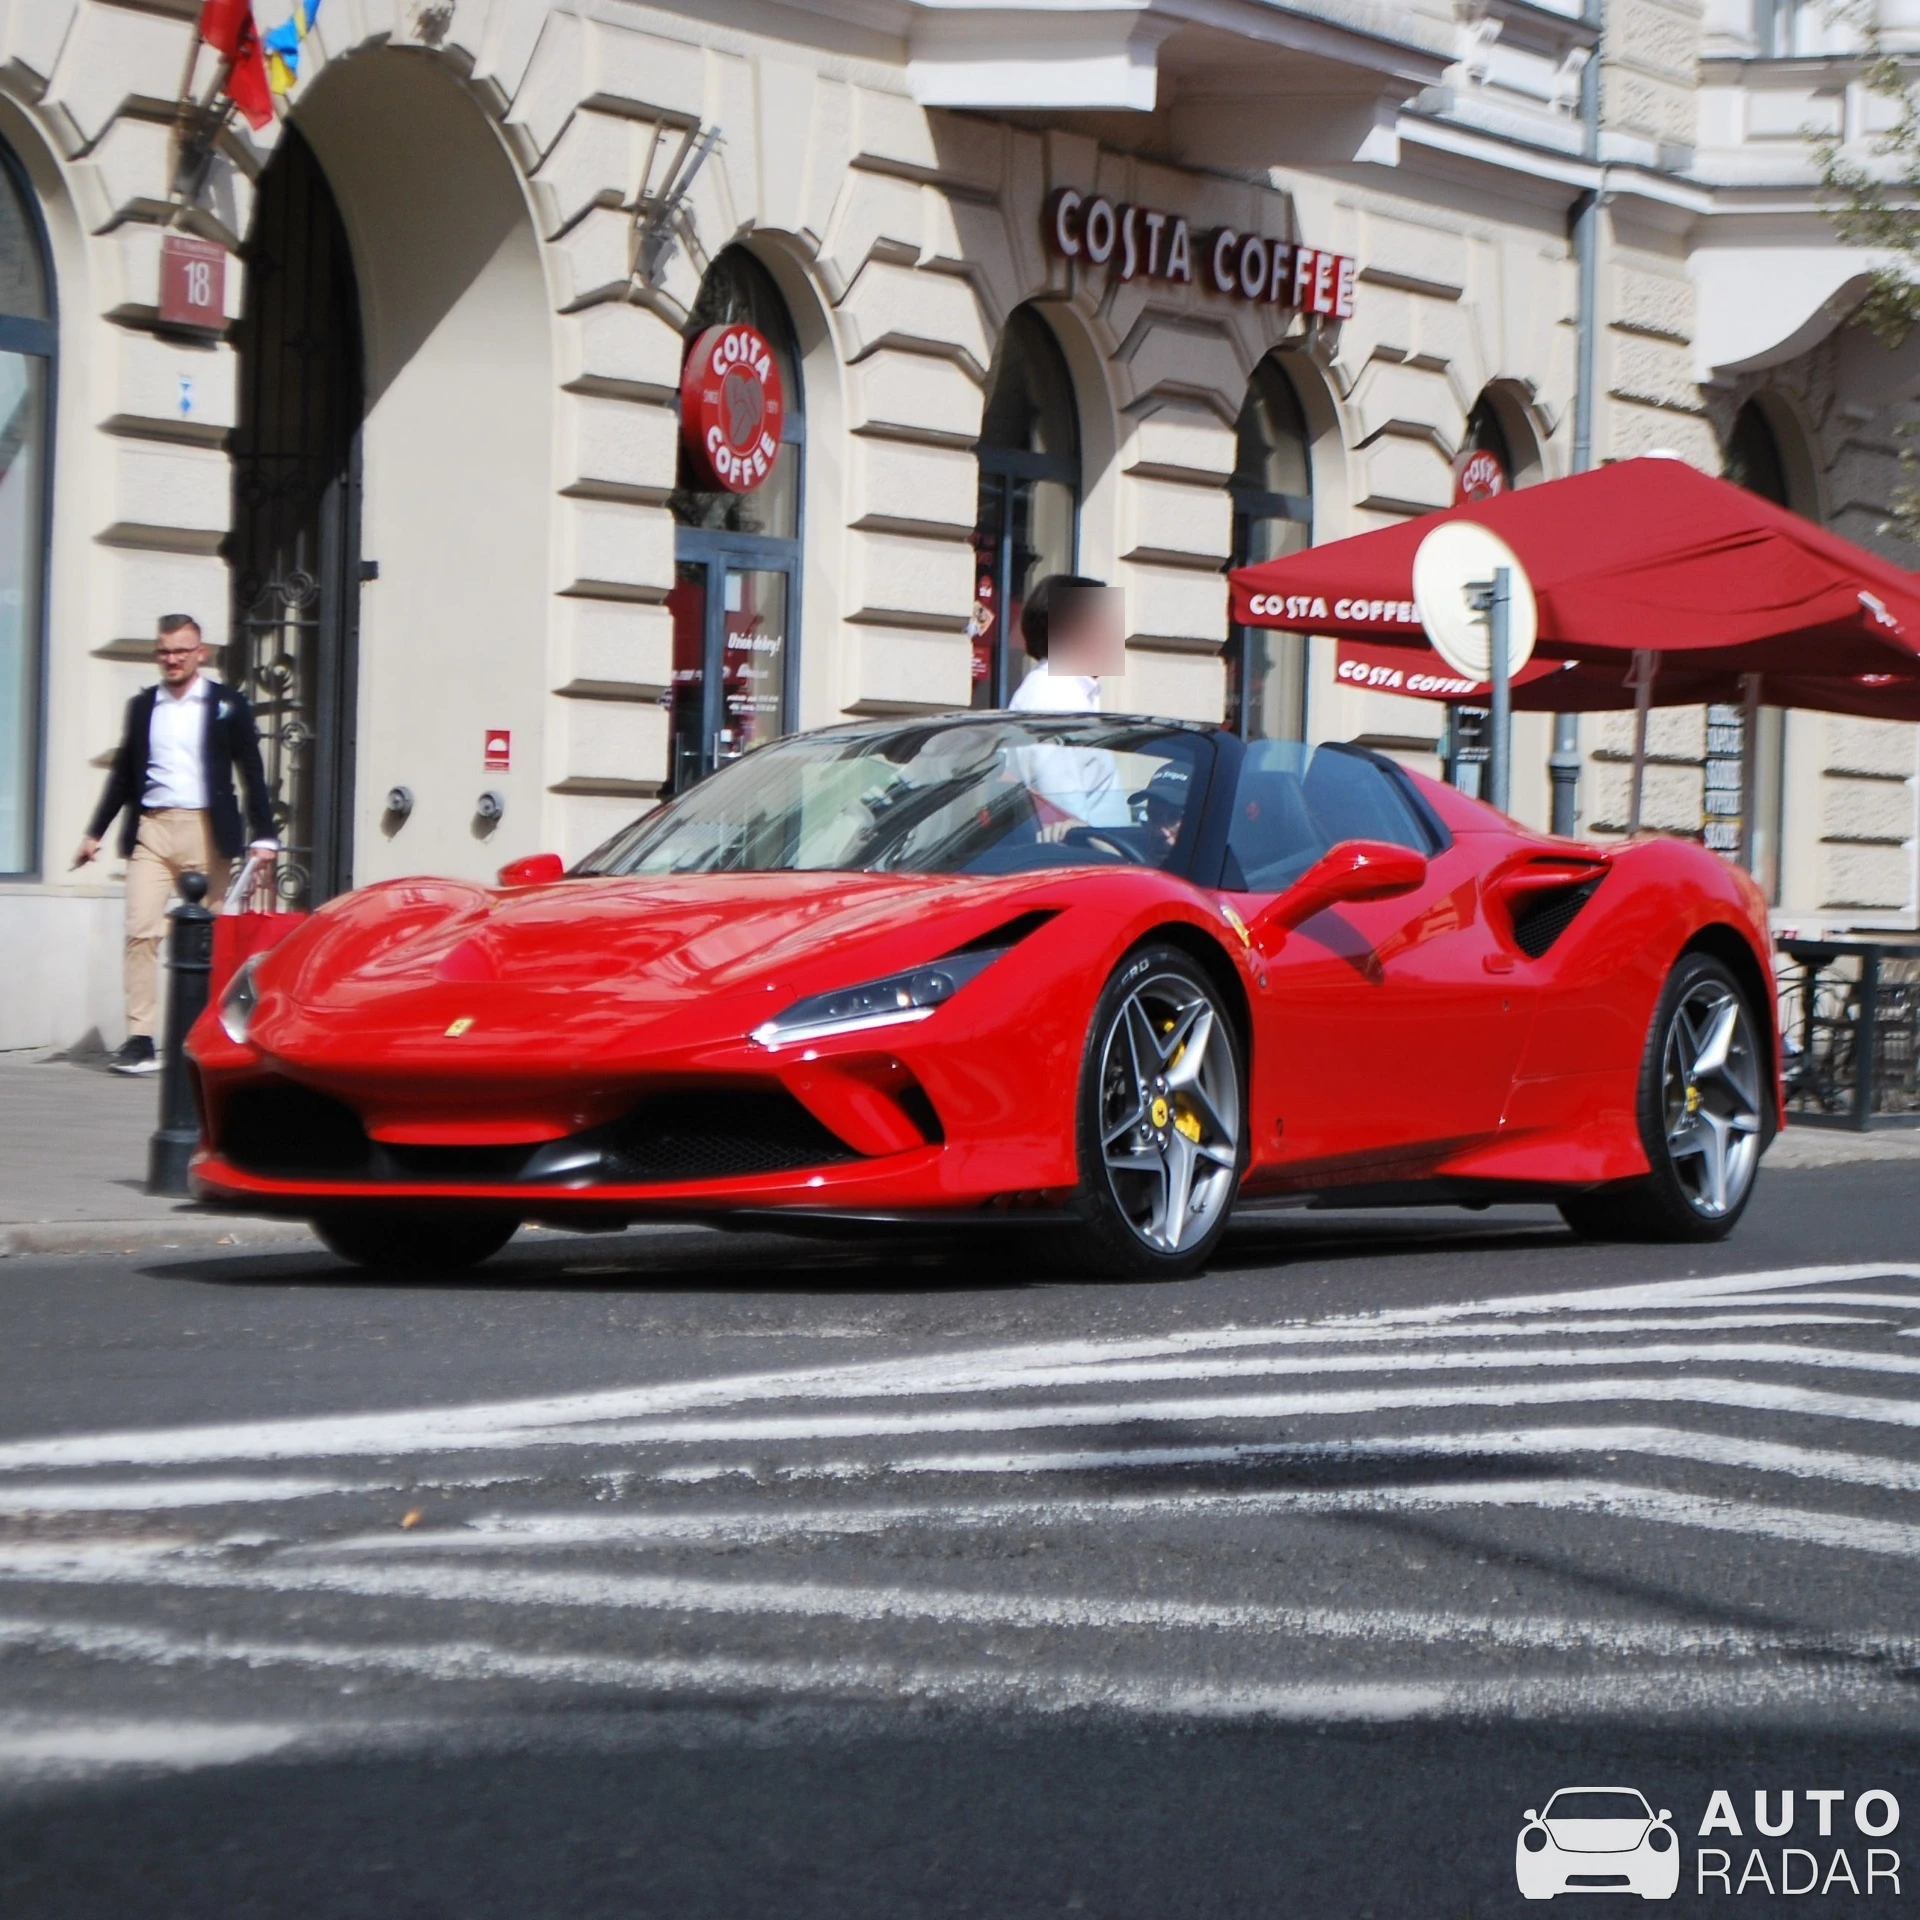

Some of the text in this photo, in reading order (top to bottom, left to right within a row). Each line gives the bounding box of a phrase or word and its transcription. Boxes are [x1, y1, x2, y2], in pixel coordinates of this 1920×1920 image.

[1056, 189, 1354, 318] COSTA COFFEE
[183, 260, 211, 306] 18
[712, 331, 771, 384] COSTA
[707, 424, 777, 486] COFFEE
[1462, 455, 1502, 497] COSTA
[1250, 594, 1328, 619] COSTA
[1338, 660, 1478, 694] COSTA COFFEE
